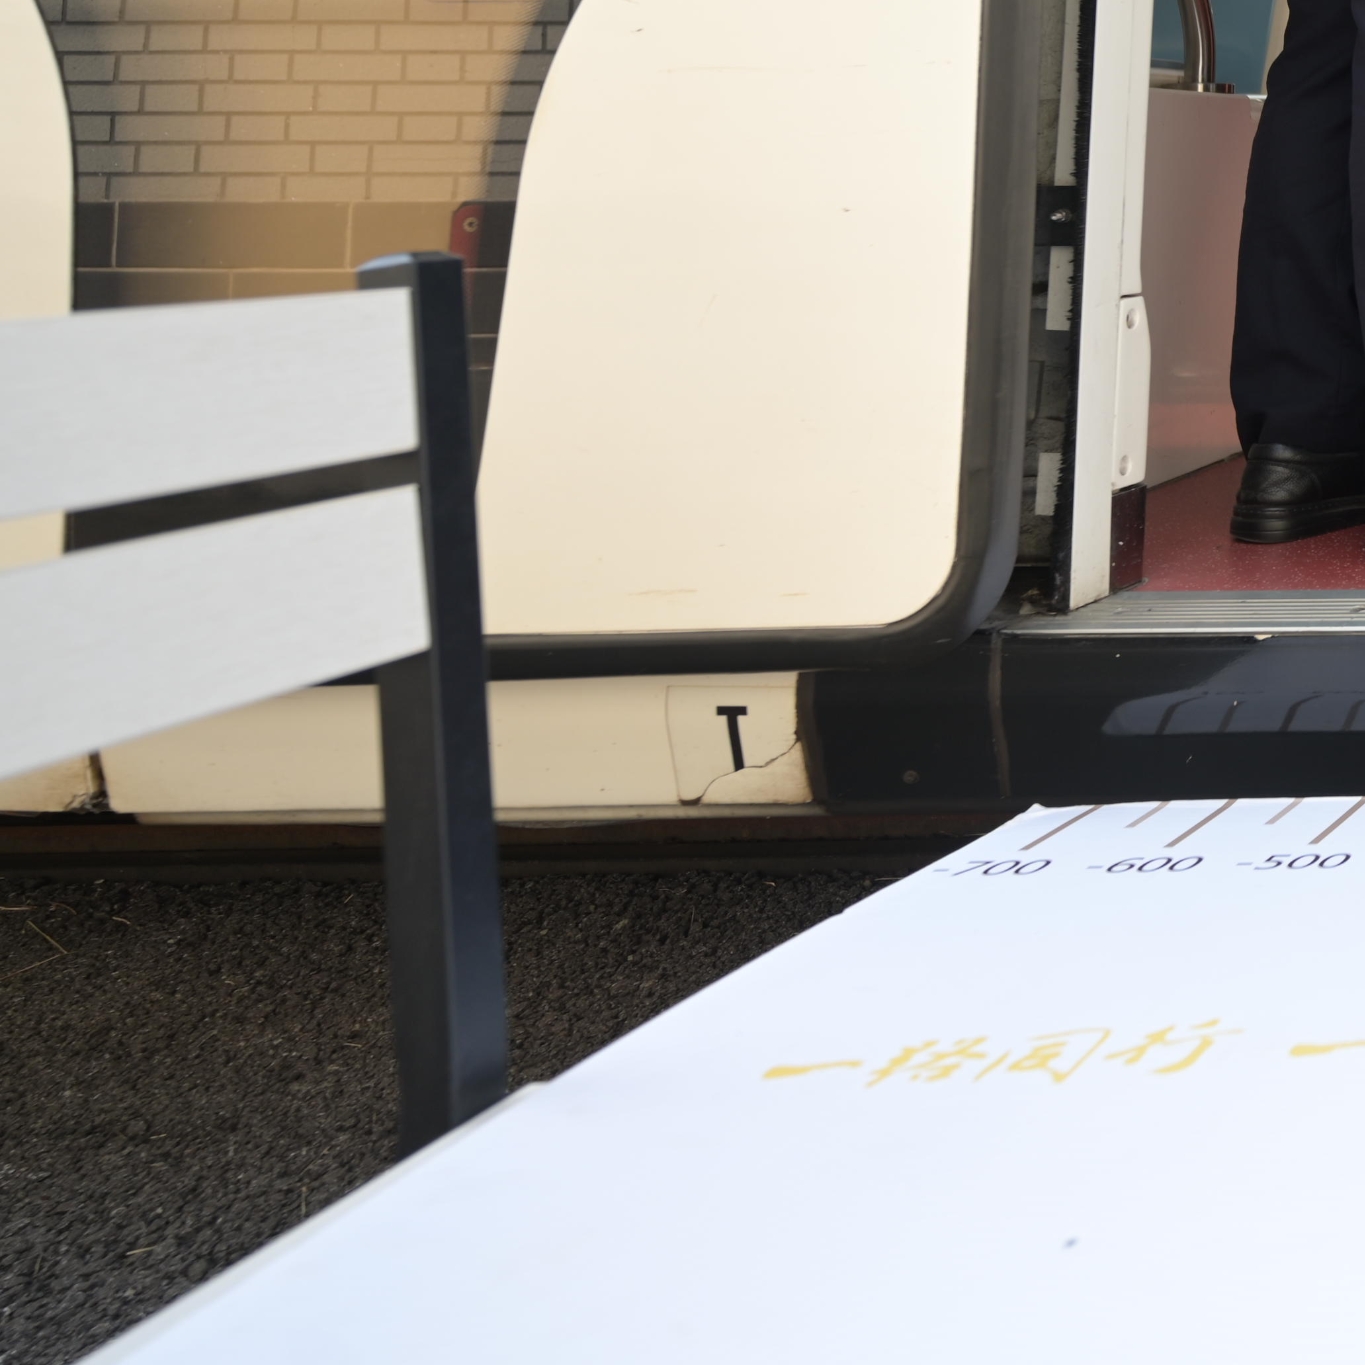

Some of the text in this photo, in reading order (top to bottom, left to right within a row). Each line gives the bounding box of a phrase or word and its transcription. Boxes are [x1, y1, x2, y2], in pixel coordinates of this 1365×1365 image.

[932, 857, 1052, 877] -700
[1087, 855, 1205, 874] -600
[1236, 852, 1352, 871] -500
